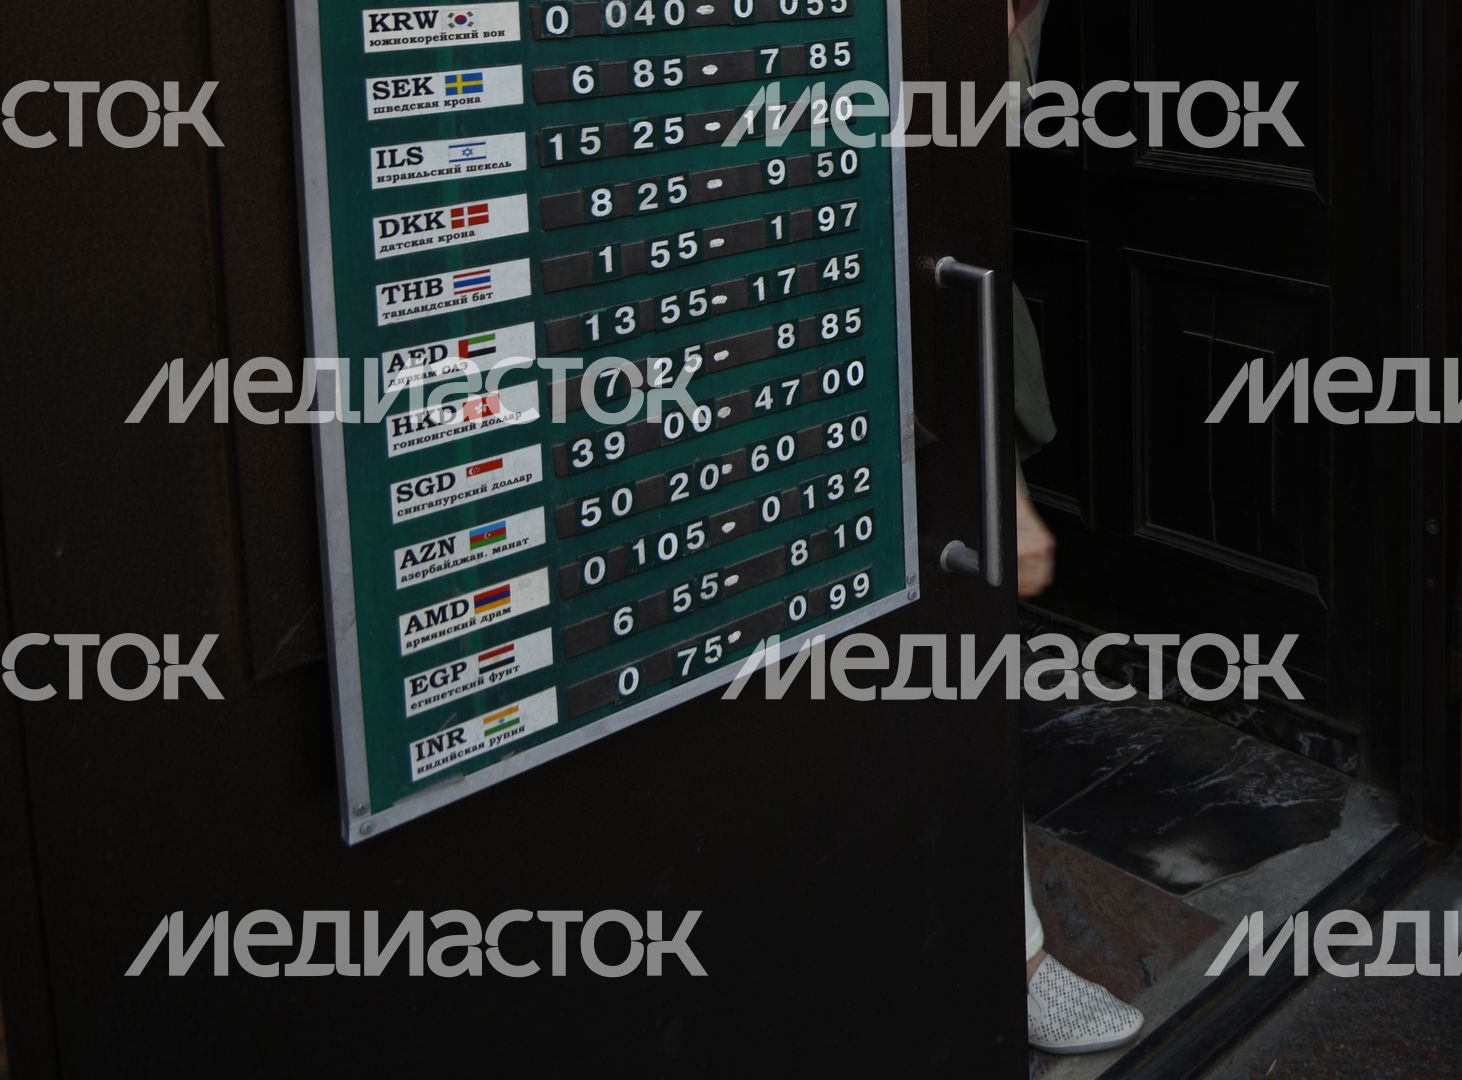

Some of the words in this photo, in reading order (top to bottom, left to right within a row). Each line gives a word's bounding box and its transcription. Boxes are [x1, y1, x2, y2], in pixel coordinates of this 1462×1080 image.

[368, 9, 440, 34] KRW
[369, 29, 479, 47] южнокорейский
[483, 30, 505, 38] вон
[572, 65, 594, 94] 6
[634, 58, 683, 88] 85
[760, 48, 779, 74] 7
[809, 41, 851, 69] 85
[372, 76, 435, 101] SEK
[373, 101, 440, 114] шведская
[443, 96, 481, 109] крона
[375, 146, 424, 170] ILS
[376, 163, 462, 184] израильский
[466, 161, 512, 173] шекель
[591, 188, 613, 217] 8
[638, 176, 687, 211] 25
[767, 159, 786, 185] 9
[817, 149, 858, 178] 50
[378, 210, 446, 239] DKK
[379, 237, 434, 254] датская
[437, 230, 476, 244] крона
[381, 277, 444, 306] THB
[382, 294, 468, 320] таиландский
[471, 291, 494, 302] бат
[387, 344, 448, 374] AED
[391, 405, 458, 438] HKD
[393, 422, 477, 451] гонконгский
[396, 471, 456, 504] SGD
[397, 483, 488, 517] сингапурский
[491, 473, 533, 492] доллар
[584, 556, 605, 585] 0
[633, 521, 705, 564] 105
[762, 496, 780, 522] 0
[803, 467, 870, 509] 132
[399, 535, 457, 570] AZN
[491, 537, 529, 555] манат
[404, 599, 470, 636] AMD
[405, 616, 477, 649] армянский
[480, 606, 512, 624] драм
[409, 661, 467, 698] EGP
[410, 675, 485, 710] египетский
[488, 664, 520, 683] фунт
[415, 727, 467, 762] INR
[417, 741, 485, 775] индийская
[489, 725, 525, 748] рупия
